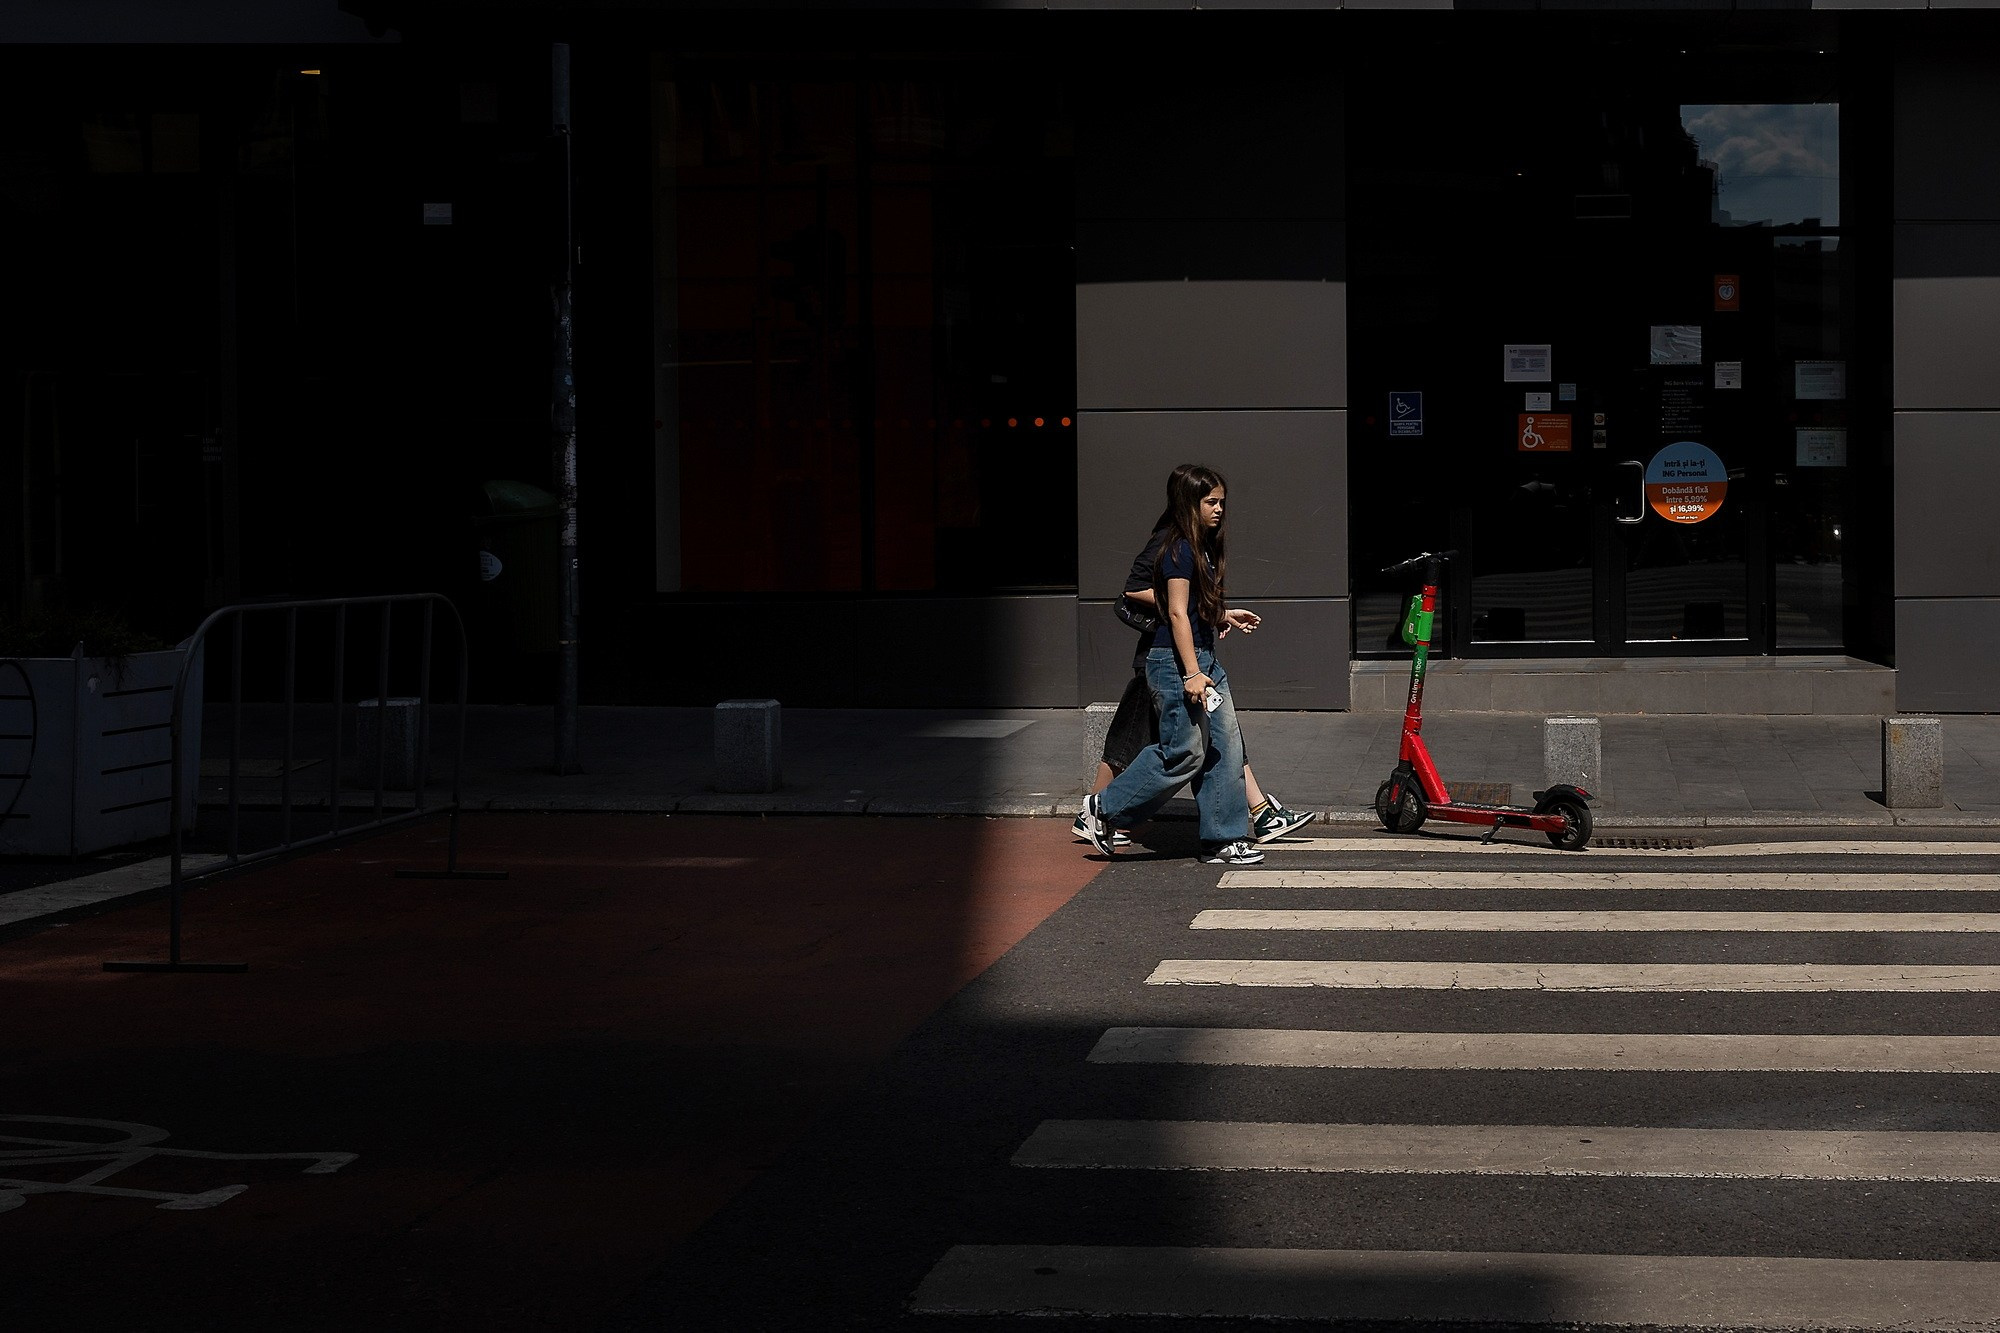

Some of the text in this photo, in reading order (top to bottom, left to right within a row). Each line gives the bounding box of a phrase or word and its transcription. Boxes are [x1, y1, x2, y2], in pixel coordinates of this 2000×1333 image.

[1677, 469, 1708, 477] Personal
[1662, 486, 1693, 494] Dobândă
[1684, 495, 1708, 504] 5,99%
[1677, 504, 1705, 513] 16,99%
